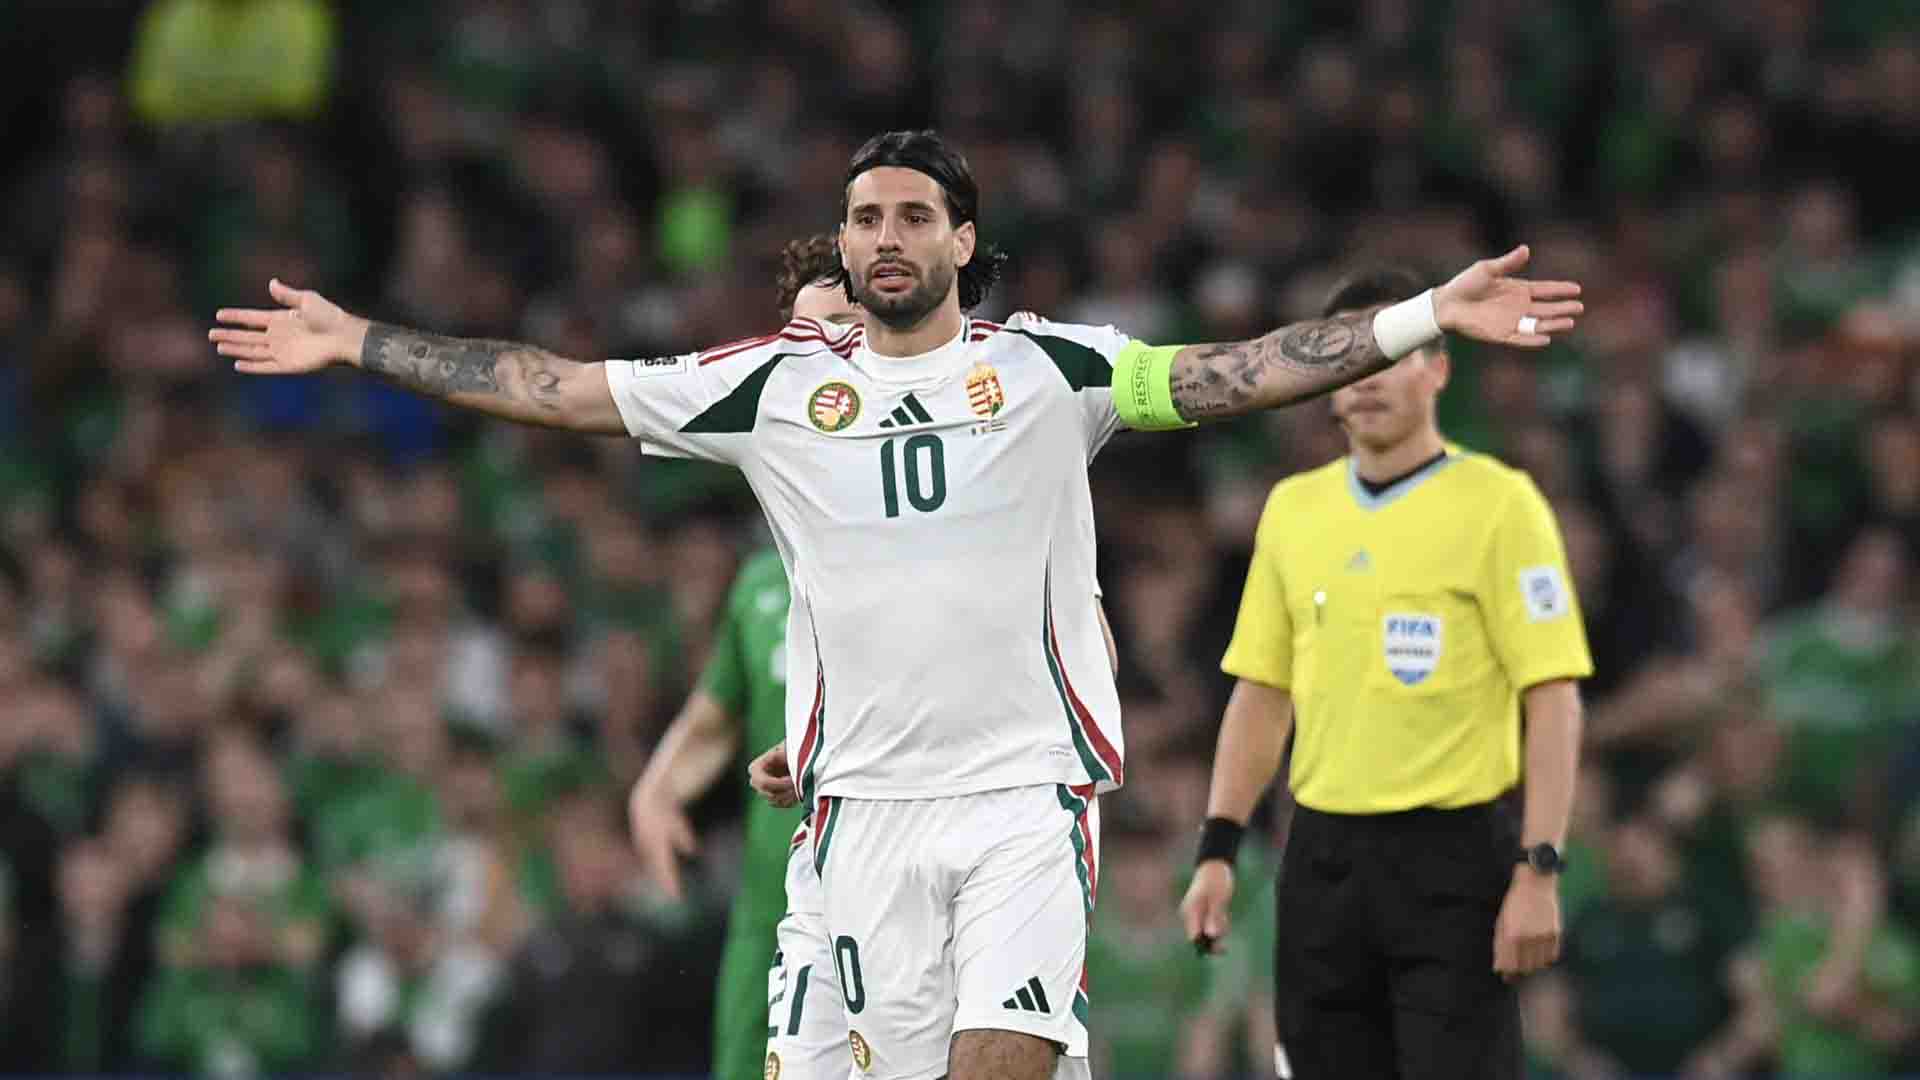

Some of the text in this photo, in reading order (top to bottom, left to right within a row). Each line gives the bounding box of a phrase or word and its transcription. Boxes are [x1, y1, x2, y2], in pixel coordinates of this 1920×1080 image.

[1135, 353, 1148, 406] RESPEC
[880, 434, 946, 518] 10
[1387, 617, 1433, 637] FIFA
[836, 935, 866, 1014] 0
